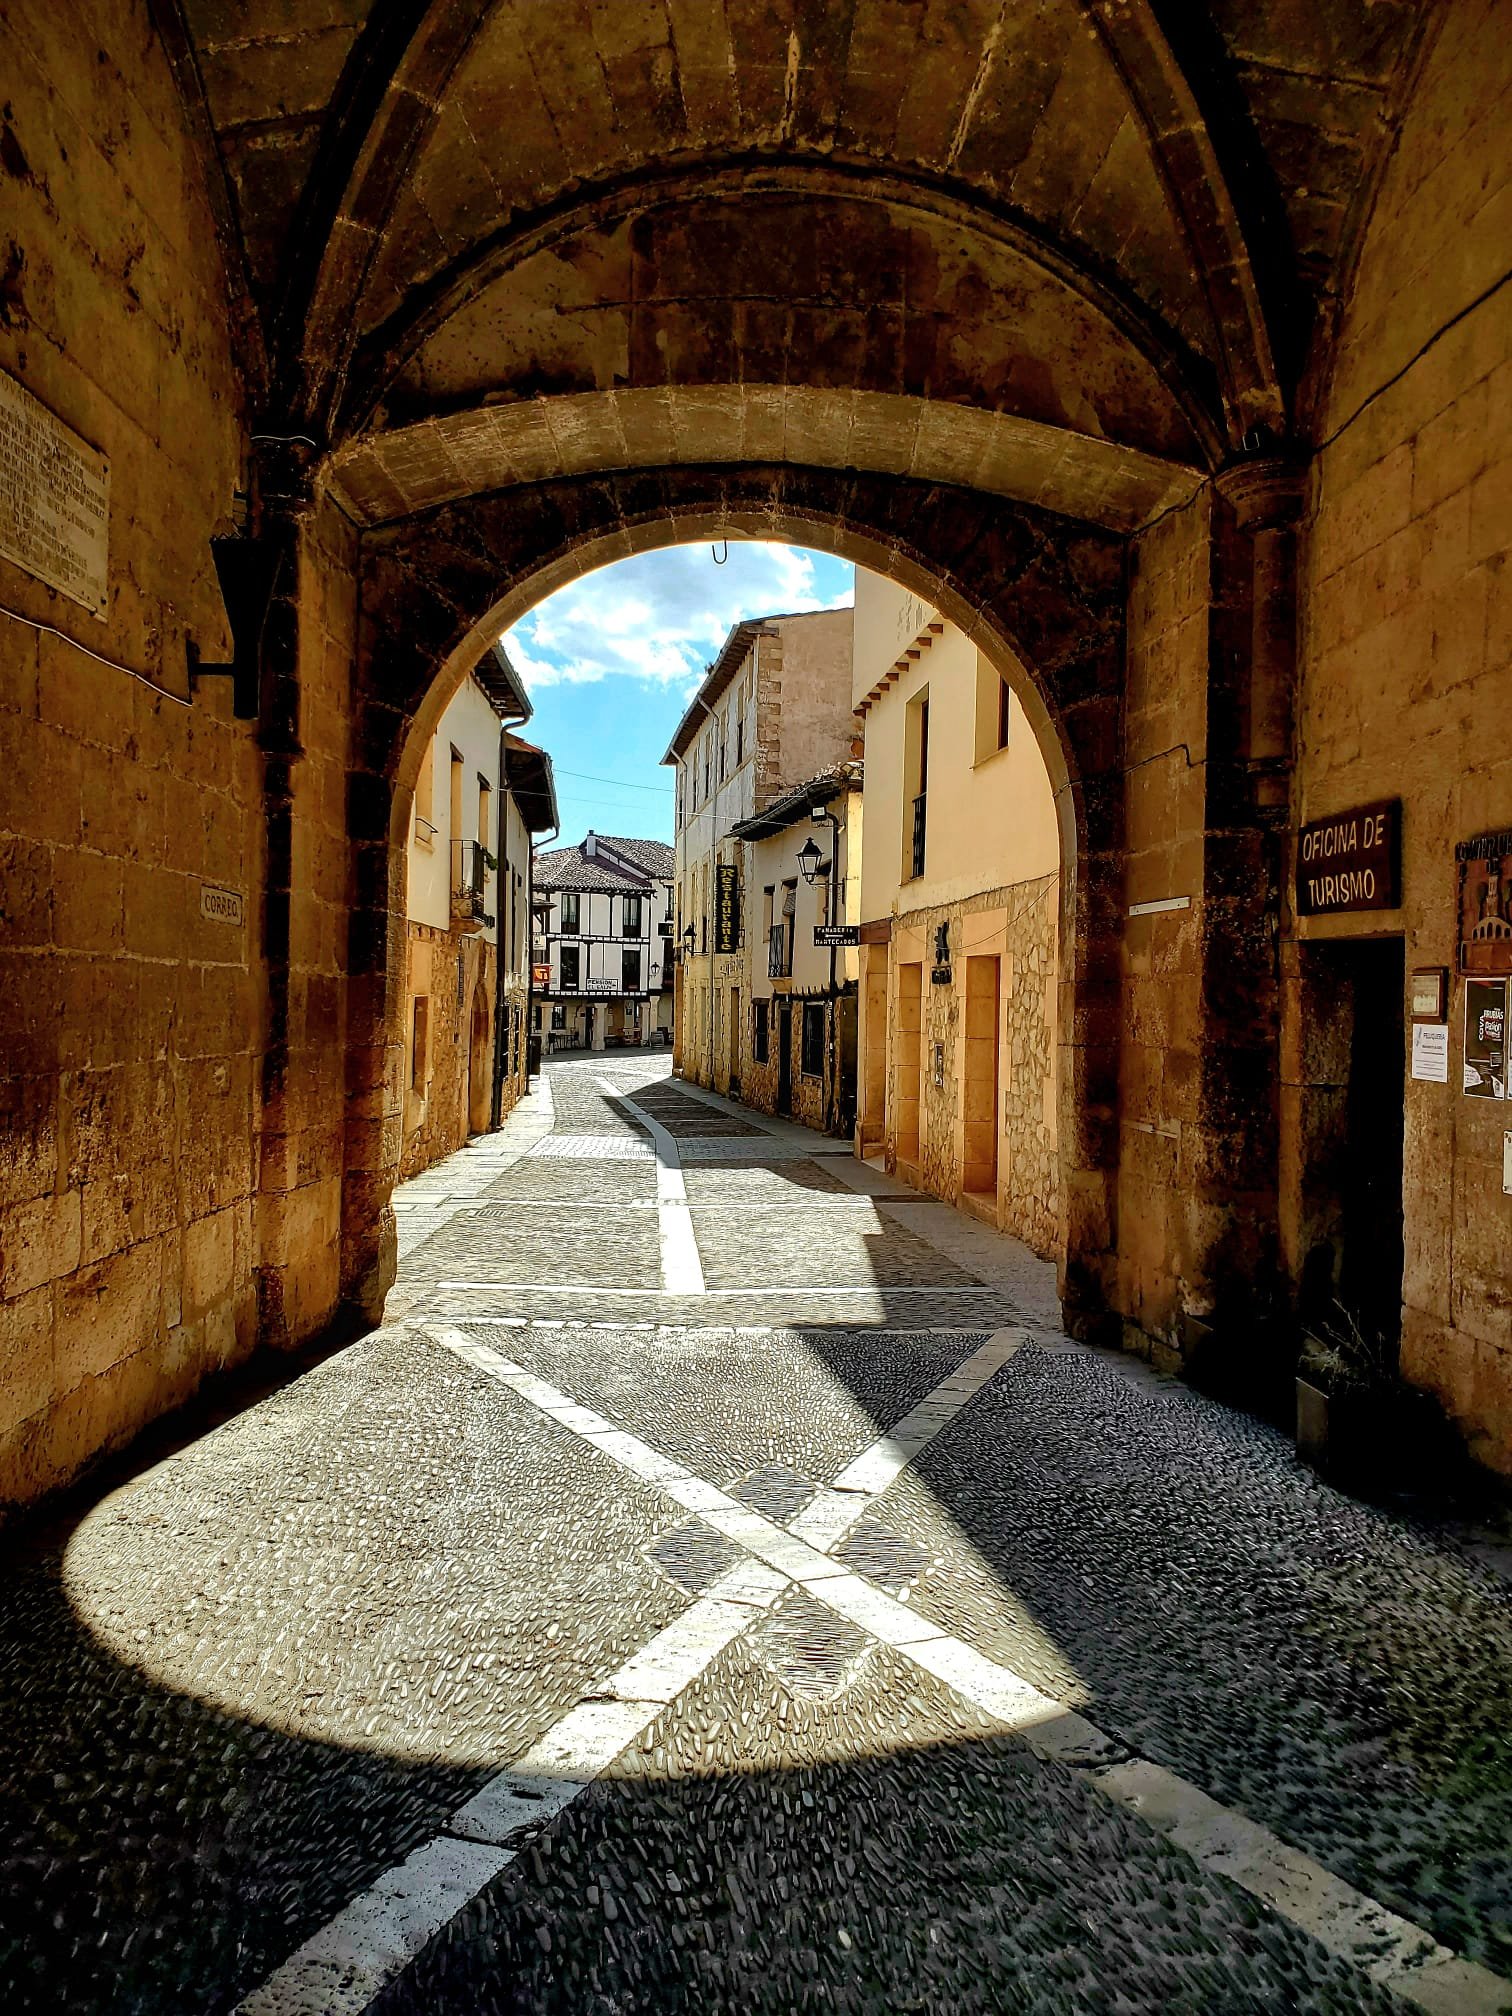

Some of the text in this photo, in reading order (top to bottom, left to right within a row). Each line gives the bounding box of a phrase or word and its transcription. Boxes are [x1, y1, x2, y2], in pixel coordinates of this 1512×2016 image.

[1303, 813, 1386, 861] OFICINA DE
[719, 867, 735, 951] Restaurante
[1307, 868, 1375, 908] TURISMO
